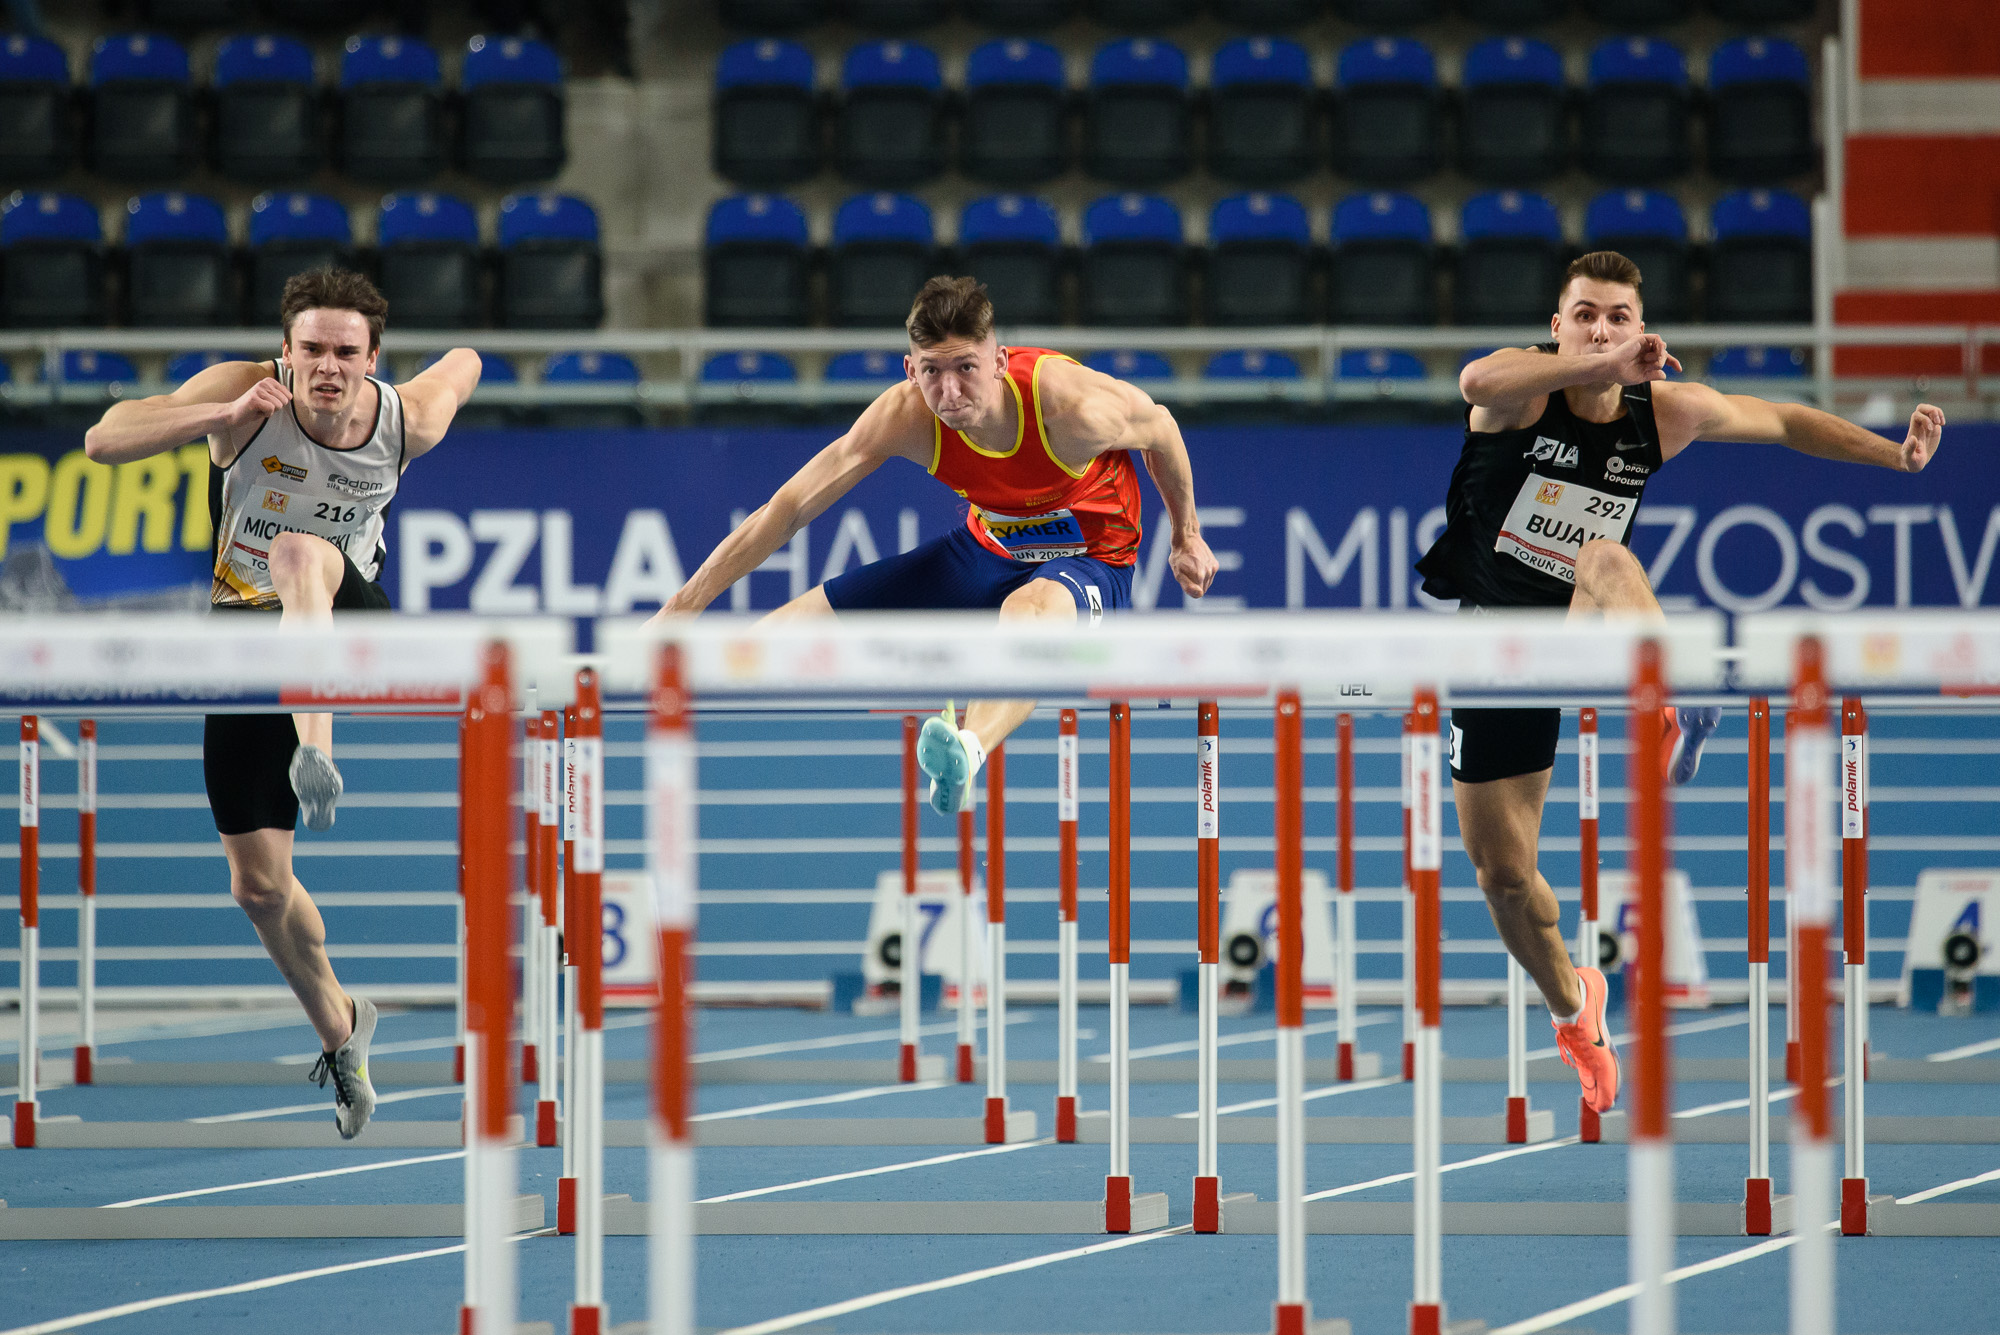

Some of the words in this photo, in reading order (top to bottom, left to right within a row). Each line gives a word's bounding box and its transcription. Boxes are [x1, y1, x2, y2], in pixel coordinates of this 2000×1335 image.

[282, 464, 307, 478] OPTIMA
[1609, 474, 1646, 486] OPOLSKIE
[1625, 464, 1650, 475] OPOLE
[314, 502, 357, 523] 216
[1584, 496, 1627, 520] 292
[402, 508, 686, 616] PZLA
[1513, 546, 1557, 572] TORUŃ
[1201, 760, 1214, 812] polanik
[1846, 760, 1859, 812] polanik
